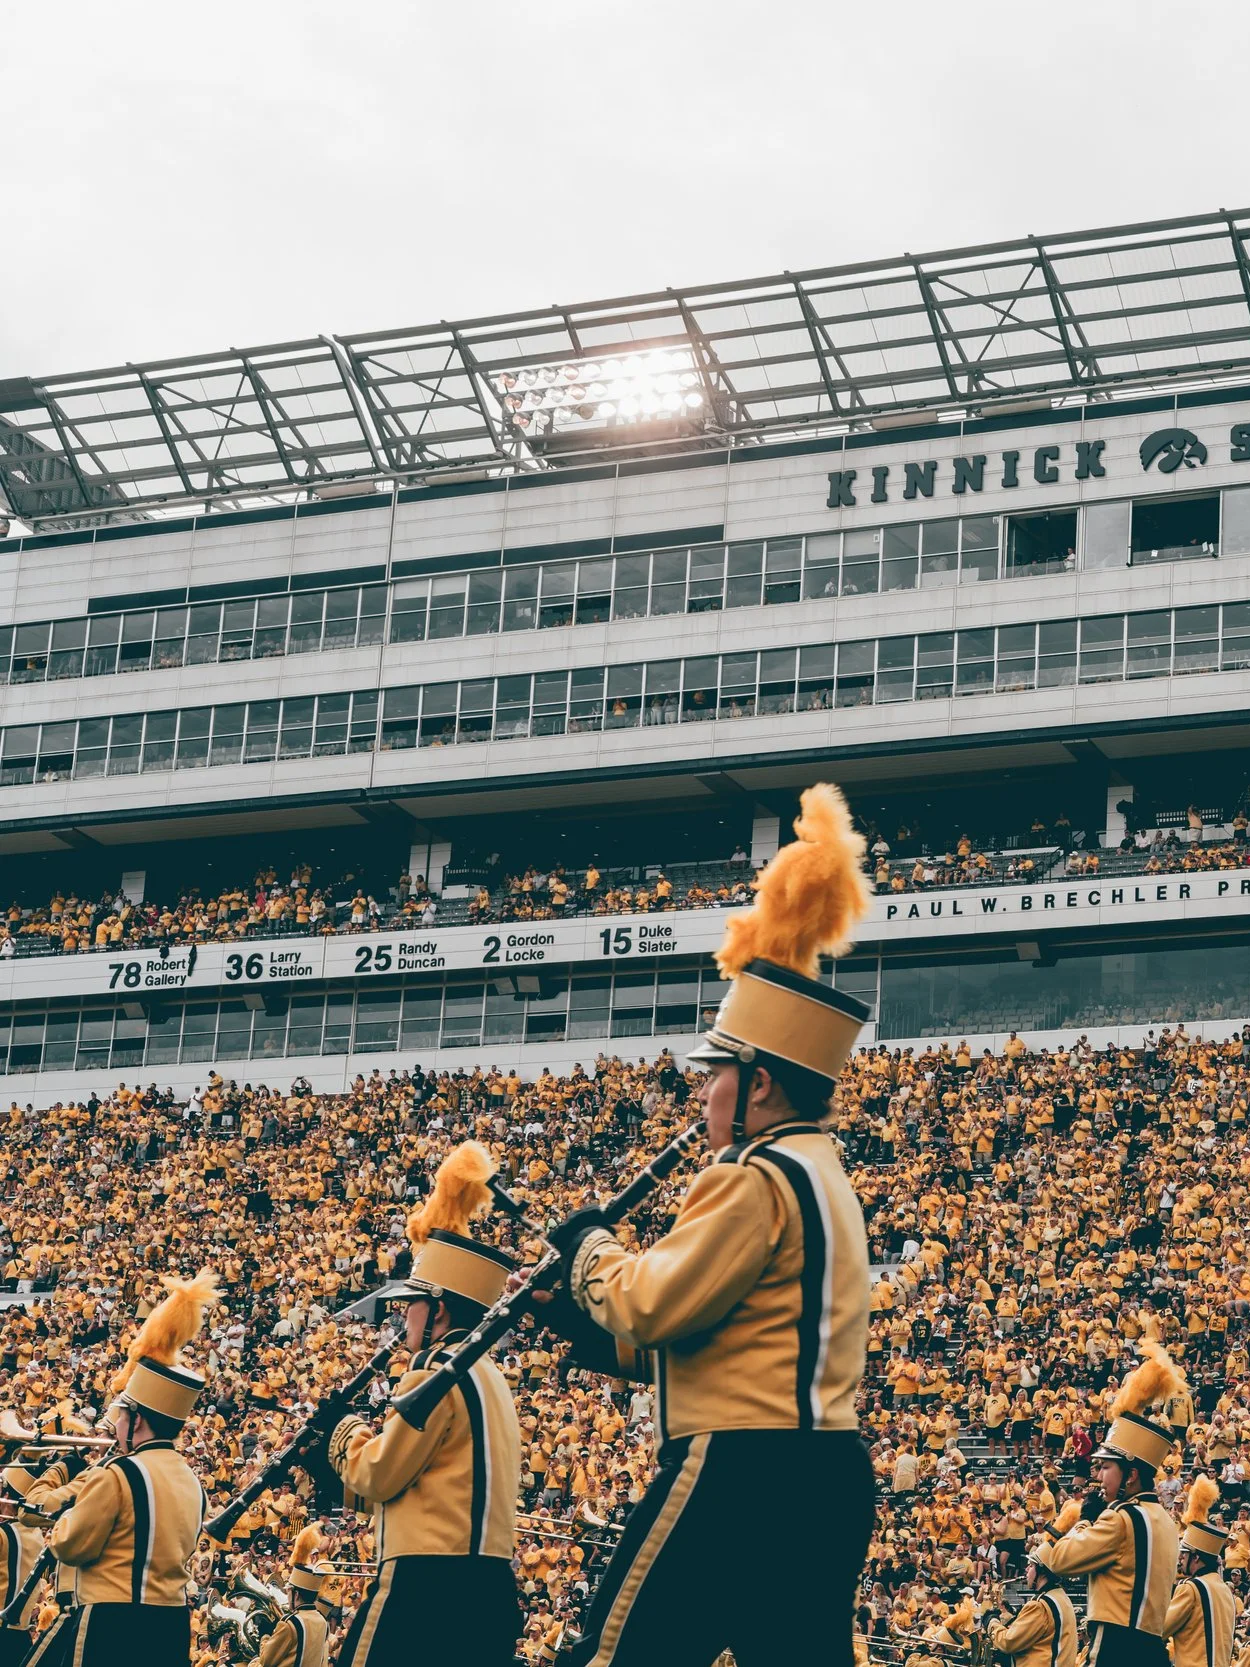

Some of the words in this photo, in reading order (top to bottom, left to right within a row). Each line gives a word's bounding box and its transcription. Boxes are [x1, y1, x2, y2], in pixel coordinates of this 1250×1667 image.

[827, 439, 1106, 509] KINNICK
[887, 901, 963, 920] PAUL
[981, 898, 1007, 913] W.
[1022, 884, 1191, 911] BRECHLER
[639, 925, 673, 938] Duke
[507, 934, 554, 947] Gordon
[600, 928, 632, 955] 15
[639, 940, 678, 953] Slater
[399, 942, 438, 955] Randy
[483, 936, 501, 963] 2
[506, 949, 545, 961] Locke
[270, 951, 302, 964] Larry
[355, 945, 392, 972] 25
[398, 957, 445, 970] Duncan
[146, 958, 187, 972] Robert
[226, 953, 264, 980] 36
[270, 965, 312, 977] Station
[109, 962, 142, 989] 78
[145, 974, 187, 987] Gallery
